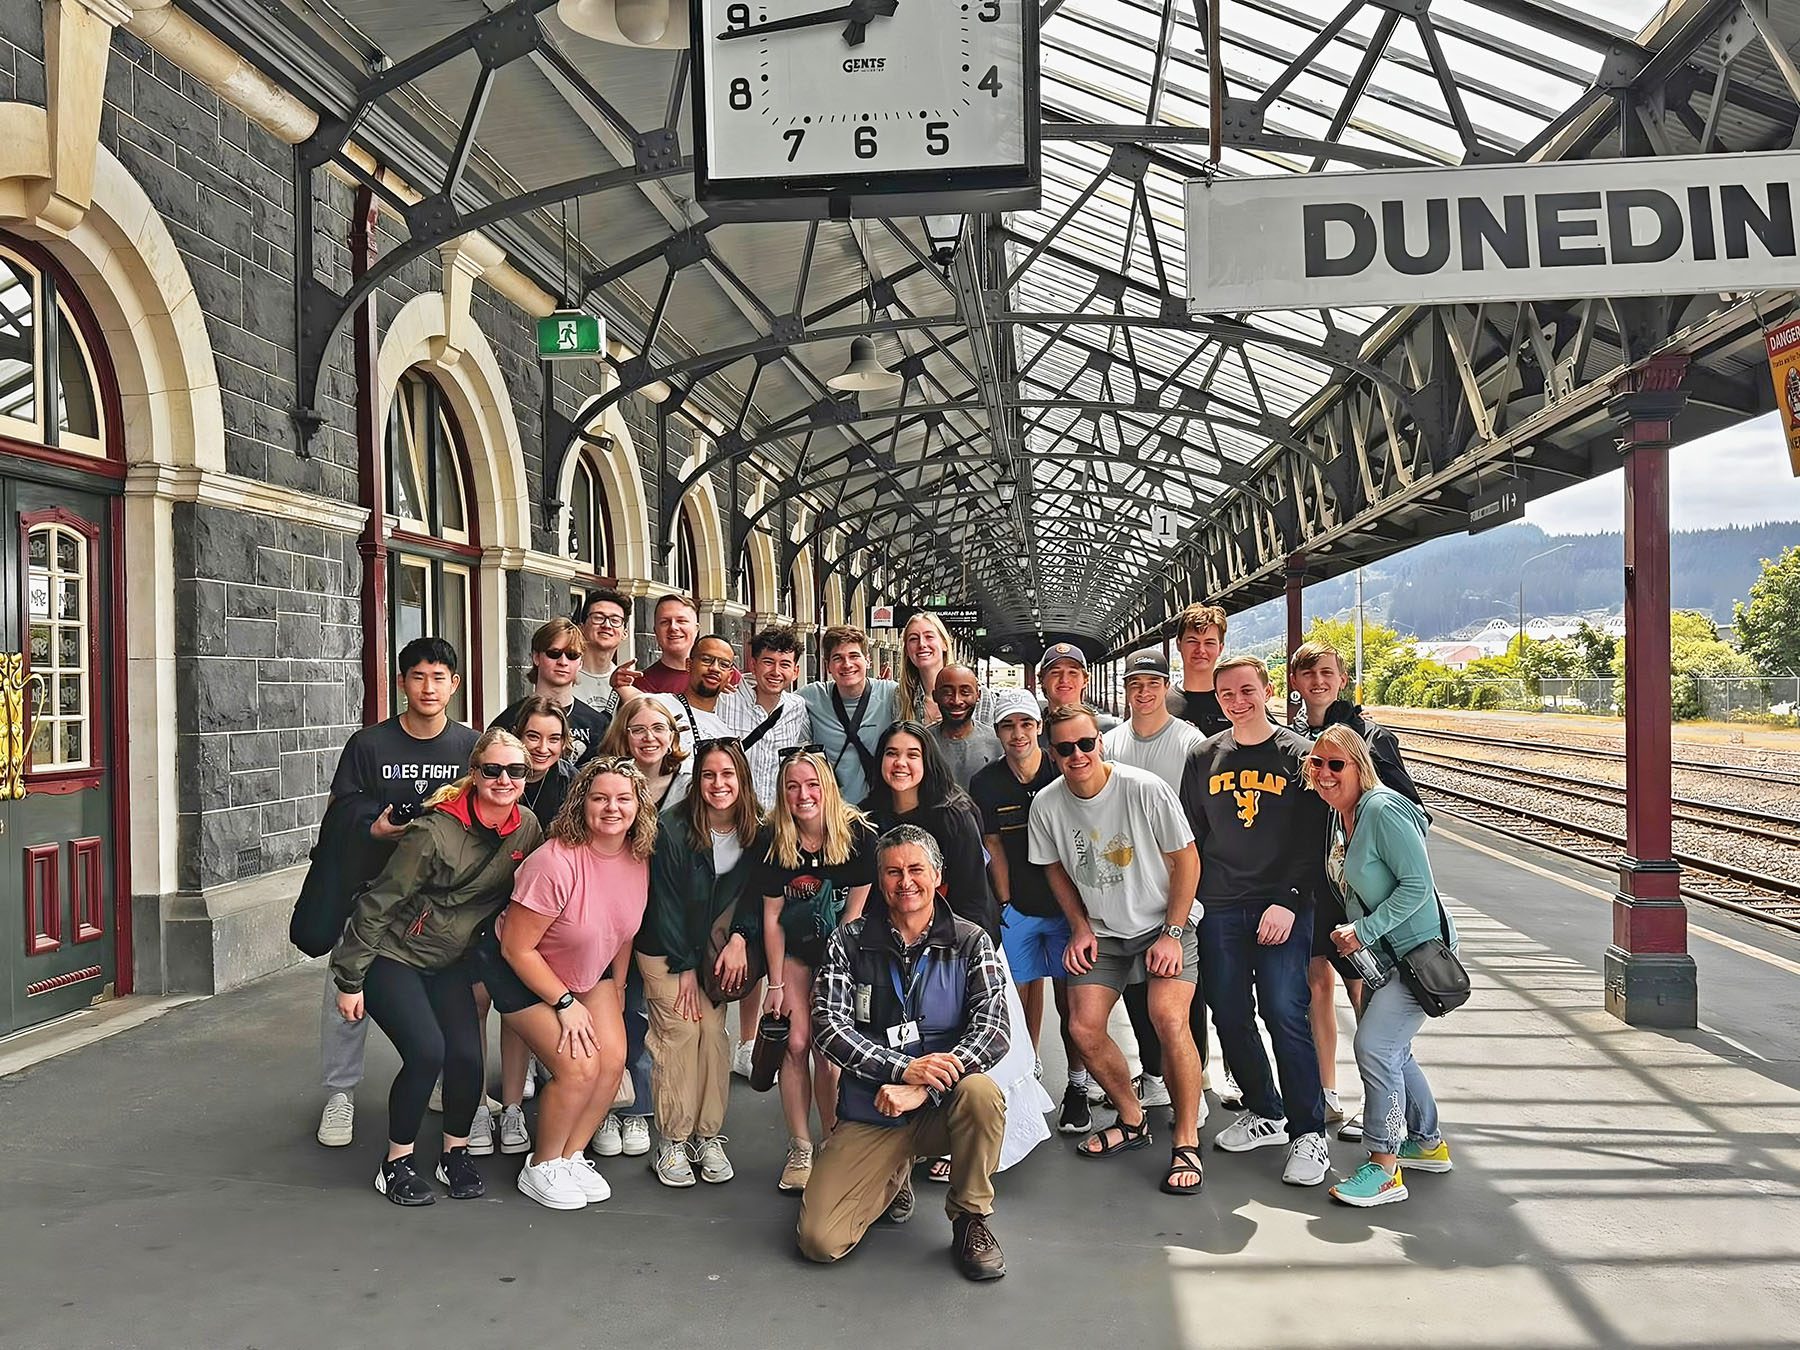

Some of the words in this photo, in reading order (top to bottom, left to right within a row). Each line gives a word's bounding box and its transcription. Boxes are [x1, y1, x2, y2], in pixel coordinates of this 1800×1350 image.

[727, 4, 750, 32] 9
[843, 58, 886, 72] GENTS
[978, 65, 1003, 97] 4
[730, 78, 752, 110] 8
[783, 129, 805, 162] 7
[854, 126, 877, 158] 6
[926, 122, 949, 155] 5
[1303, 182, 1797, 278] DUNEDIN
[1159, 515, 1170, 535] 1
[422, 764, 460, 779] FIGHT
[1209, 771, 1235, 795] ST.
[1240, 769, 1287, 796] OLAF
